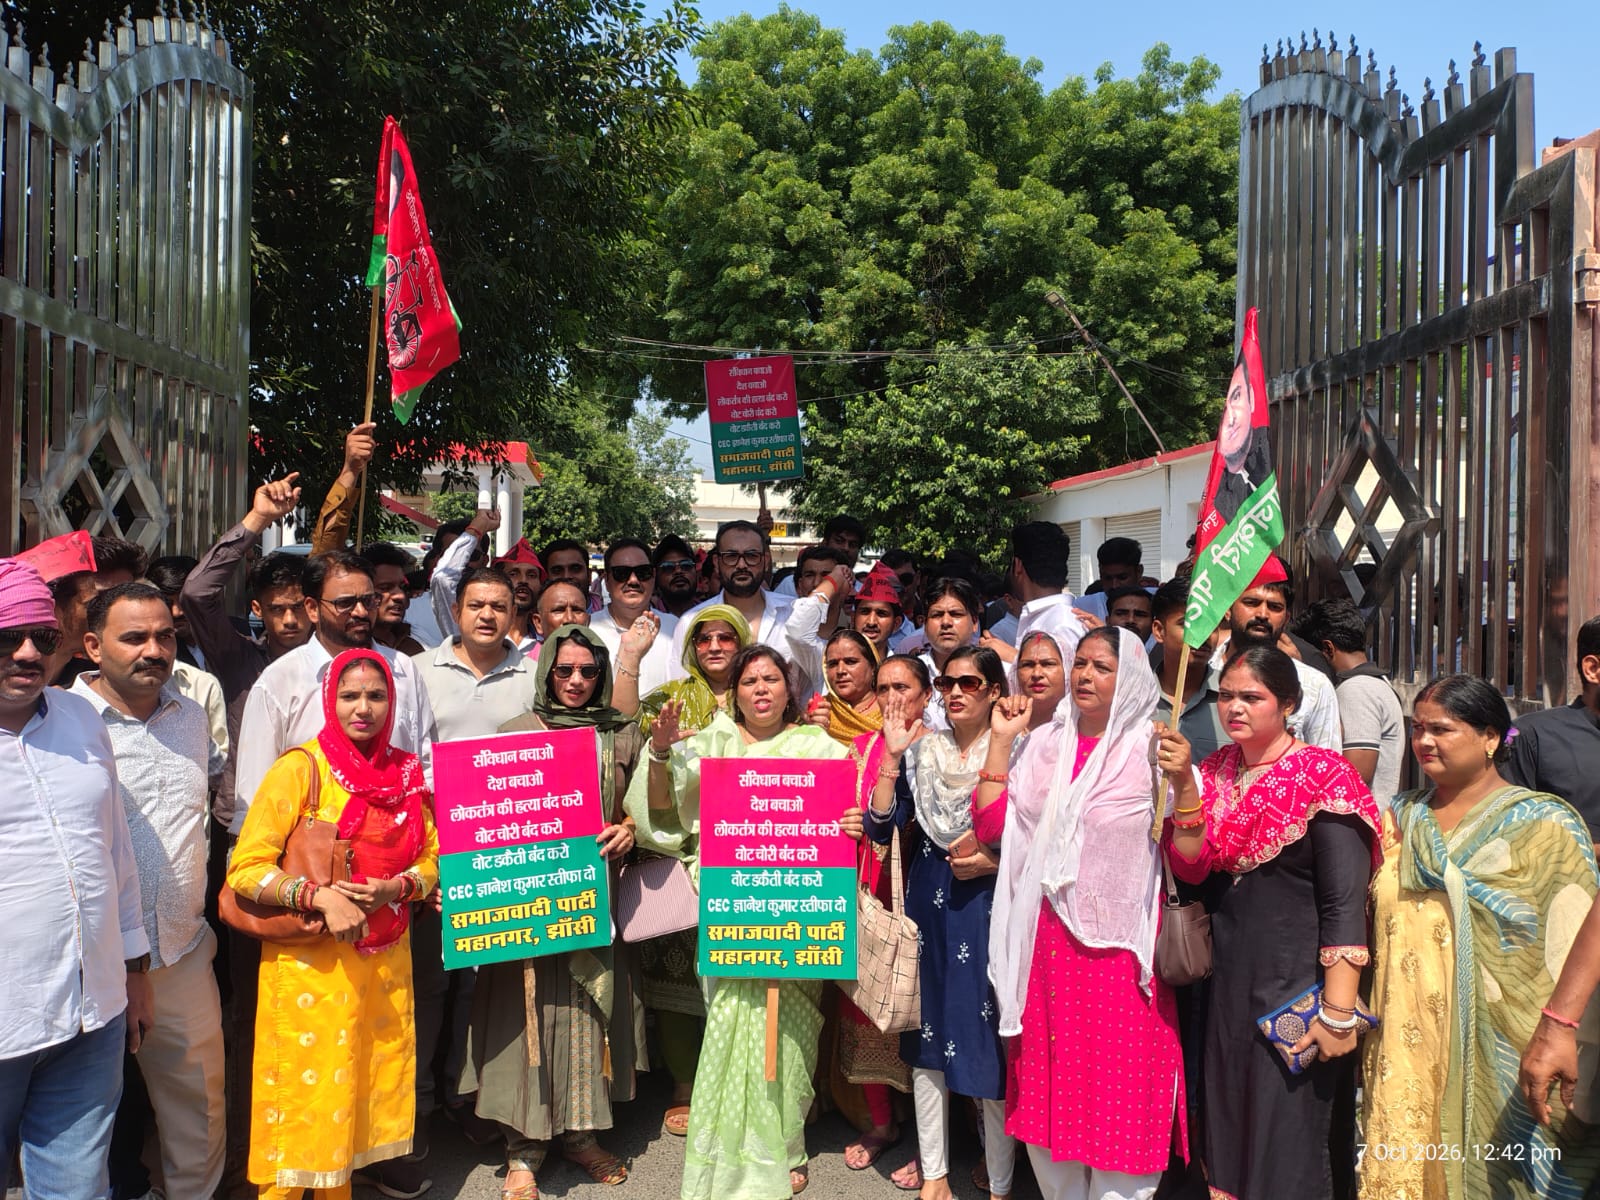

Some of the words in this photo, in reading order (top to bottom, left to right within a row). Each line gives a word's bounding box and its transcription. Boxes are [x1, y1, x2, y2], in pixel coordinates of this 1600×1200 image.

[720, 449, 771, 463] समाजवादी
[774, 447, 795, 458] पार्टी
[722, 465, 766, 475] महानगर,
[473, 749, 517, 767] संविधान
[519, 743, 554, 762] बचाओ
[487, 775, 506, 791] देश
[508, 769, 544, 788] बचाओ
[739, 770, 780, 787] संविधान
[782, 771, 815, 787] बचाओ
[450, 800, 495, 822] लोकतंत्र
[497, 798, 513, 815] की
[515, 799, 540, 813] हत्या
[542, 792, 559, 809] बंद
[561, 790, 583, 806] करो
[751, 795, 768, 812] देश
[770, 795, 803, 812] बचाओ
[475, 827, 495, 844] वोट
[497, 822, 520, 840] चोरी
[522, 820, 538, 837] बंद
[541, 818, 562, 834] करो
[714, 818, 755, 837] लोकतंत्र
[757, 820, 772, 836] की
[774, 823, 798, 836] हत्या
[800, 819, 816, 836] बंद
[818, 820, 840, 836] करो
[472, 854, 493, 871] वोट
[494, 848, 526, 867] डकैती
[528, 845, 545, 863] बंद
[547, 843, 569, 859] करो
[735, 845, 754, 861] वोट
[755, 845, 777, 861] चोरी
[779, 844, 794, 861] बंद
[797, 845, 817, 861] करो
[448, 884, 473, 900] CEC
[476, 877, 511, 897] ज्ञानेश
[513, 874, 545, 895] कुमार
[547, 868, 581, 886] स्तीफा
[583, 865, 596, 880] दो
[731, 871, 750, 887] वोट
[751, 870, 781, 887] डकैती
[784, 870, 799, 886] बंद
[802, 871, 823, 887] करो
[450, 897, 552, 929] समाजवादी
[556, 889, 597, 912] पार्टी
[707, 899, 730, 912] CEC
[733, 896, 765, 912] ज्ञानेश
[768, 899, 799, 917] कुमार
[800, 896, 832, 912] स्तीफा
[834, 896, 846, 912] दो
[454, 927, 540, 953] महानगर,
[708, 921, 802, 941] समाजवादी
[806, 921, 846, 941] पार्टी
[709, 950, 789, 968] महानगर,
